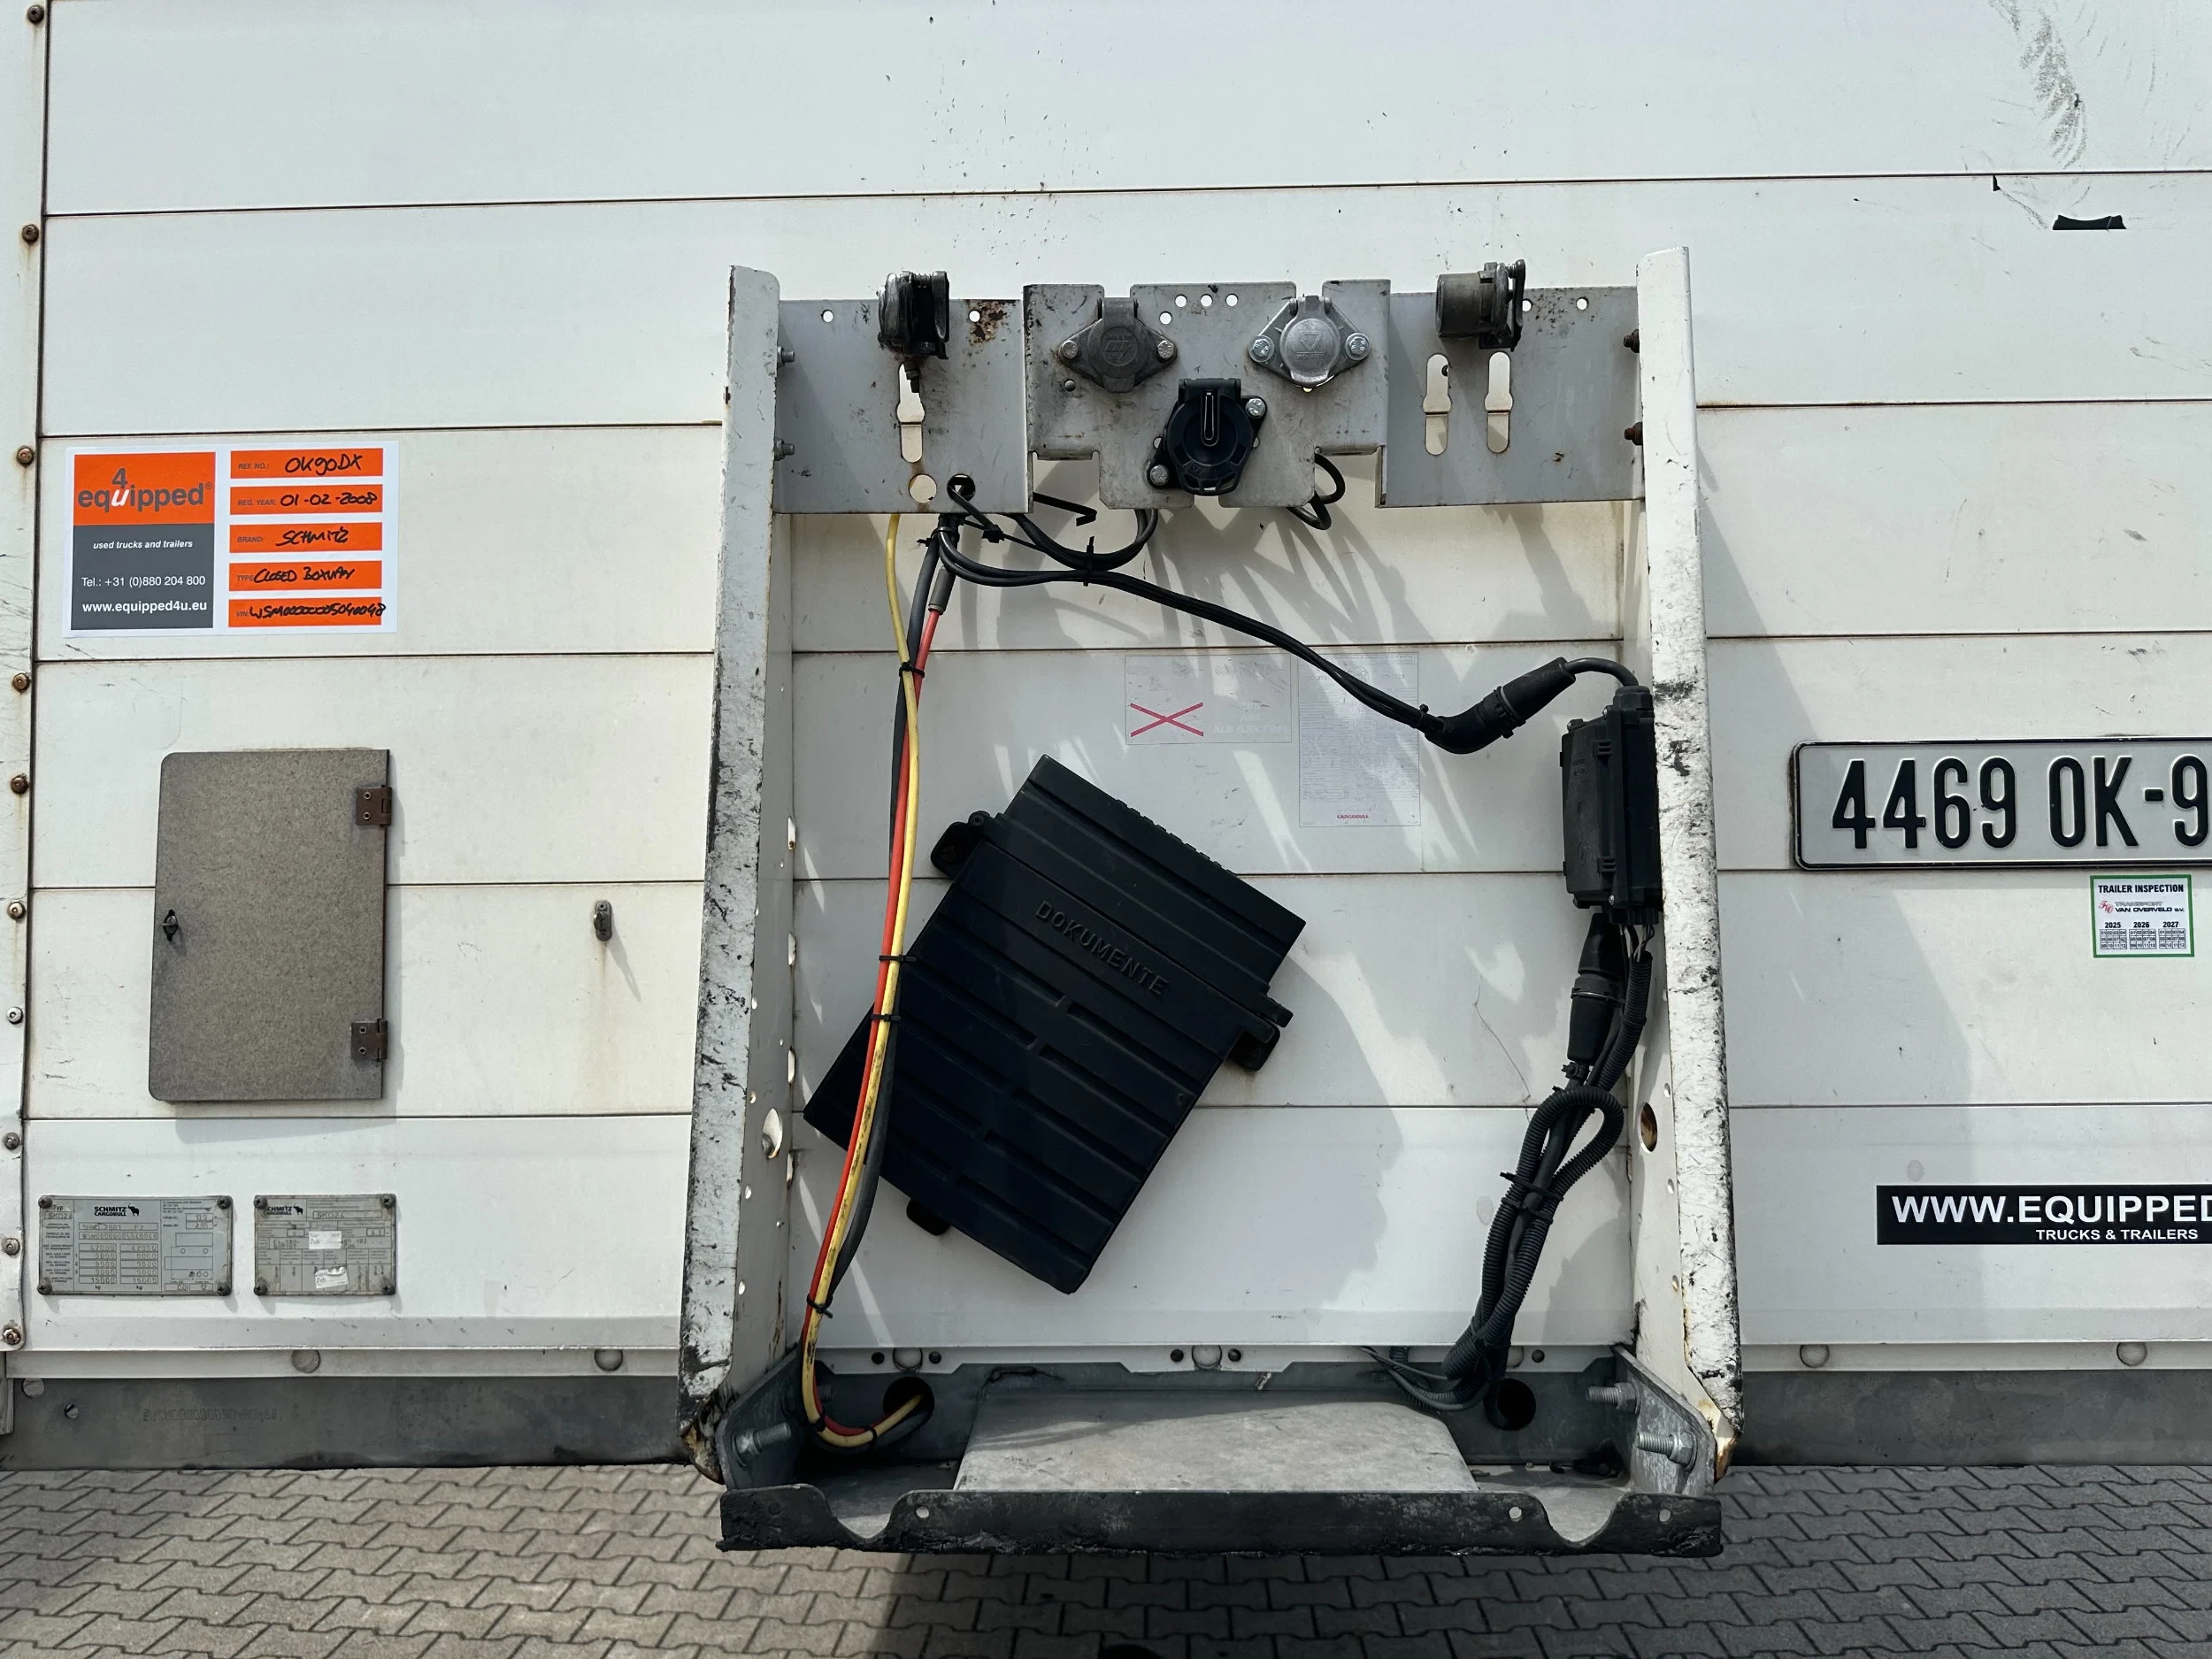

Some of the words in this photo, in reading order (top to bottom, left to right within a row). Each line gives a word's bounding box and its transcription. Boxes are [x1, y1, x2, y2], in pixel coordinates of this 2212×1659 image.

[275, 526, 349, 547] SCHMITZ
[81, 577, 102, 587] Tel.:
[104, 577, 125, 586] +31
[129, 576, 162, 588] (0)880
[165, 576, 184, 585] 204
[186, 575, 206, 585] 800
[253, 568, 297, 583] CLOSED
[303, 565, 356, 581] BOXVAN
[82, 601, 208, 614] www.equipped4u.eu
[1832, 757, 2017, 849] 4469
[2134, 884, 2184, 893] INSPECTION
[1035, 900, 1169, 995] DOKUMENTE
[2035, 1229, 2101, 1240] TRUCKS
[2105, 1230, 2116, 1240] &
[2120, 1228, 2199, 1240] TRAILERS
